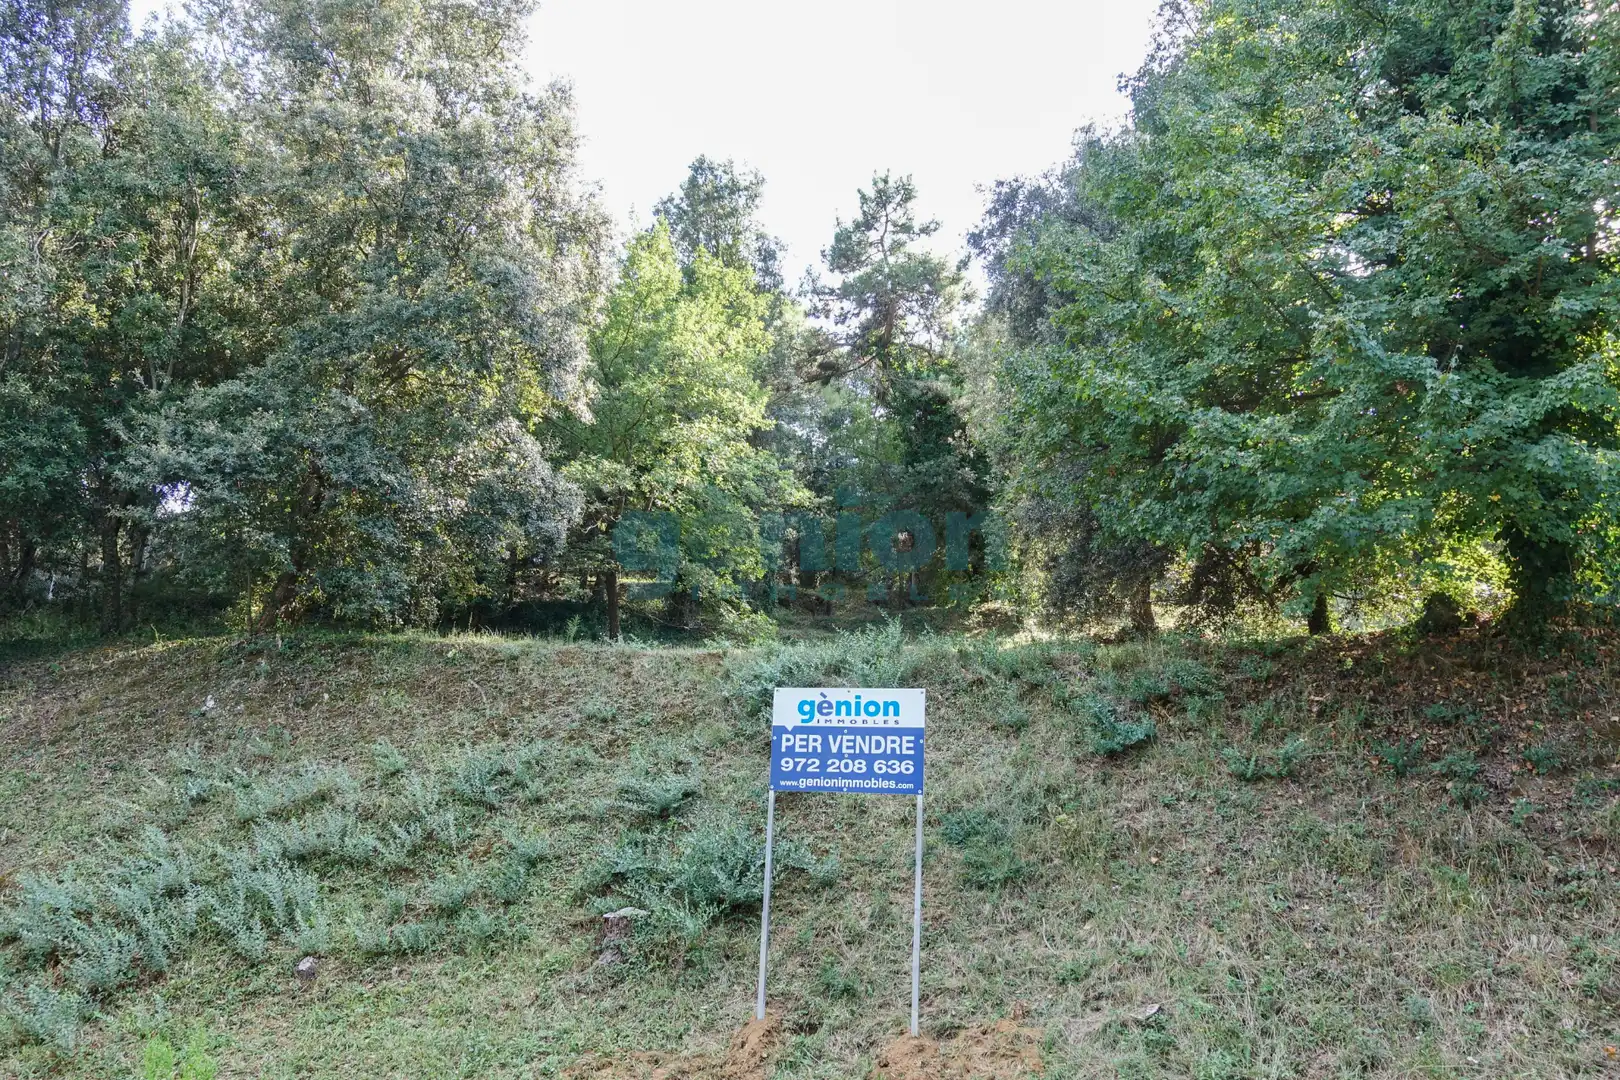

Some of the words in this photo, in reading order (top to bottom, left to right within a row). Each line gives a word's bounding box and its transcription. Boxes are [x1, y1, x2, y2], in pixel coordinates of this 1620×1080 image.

[798, 691, 900, 724] gènion
[781, 733, 822, 753] PER
[828, 734, 915, 755] VENDRE
[780, 757, 820, 772] 972
[826, 758, 867, 773] 208
[873, 759, 914, 774] 636
[780, 776, 914, 789] www.genionimmobles.com
